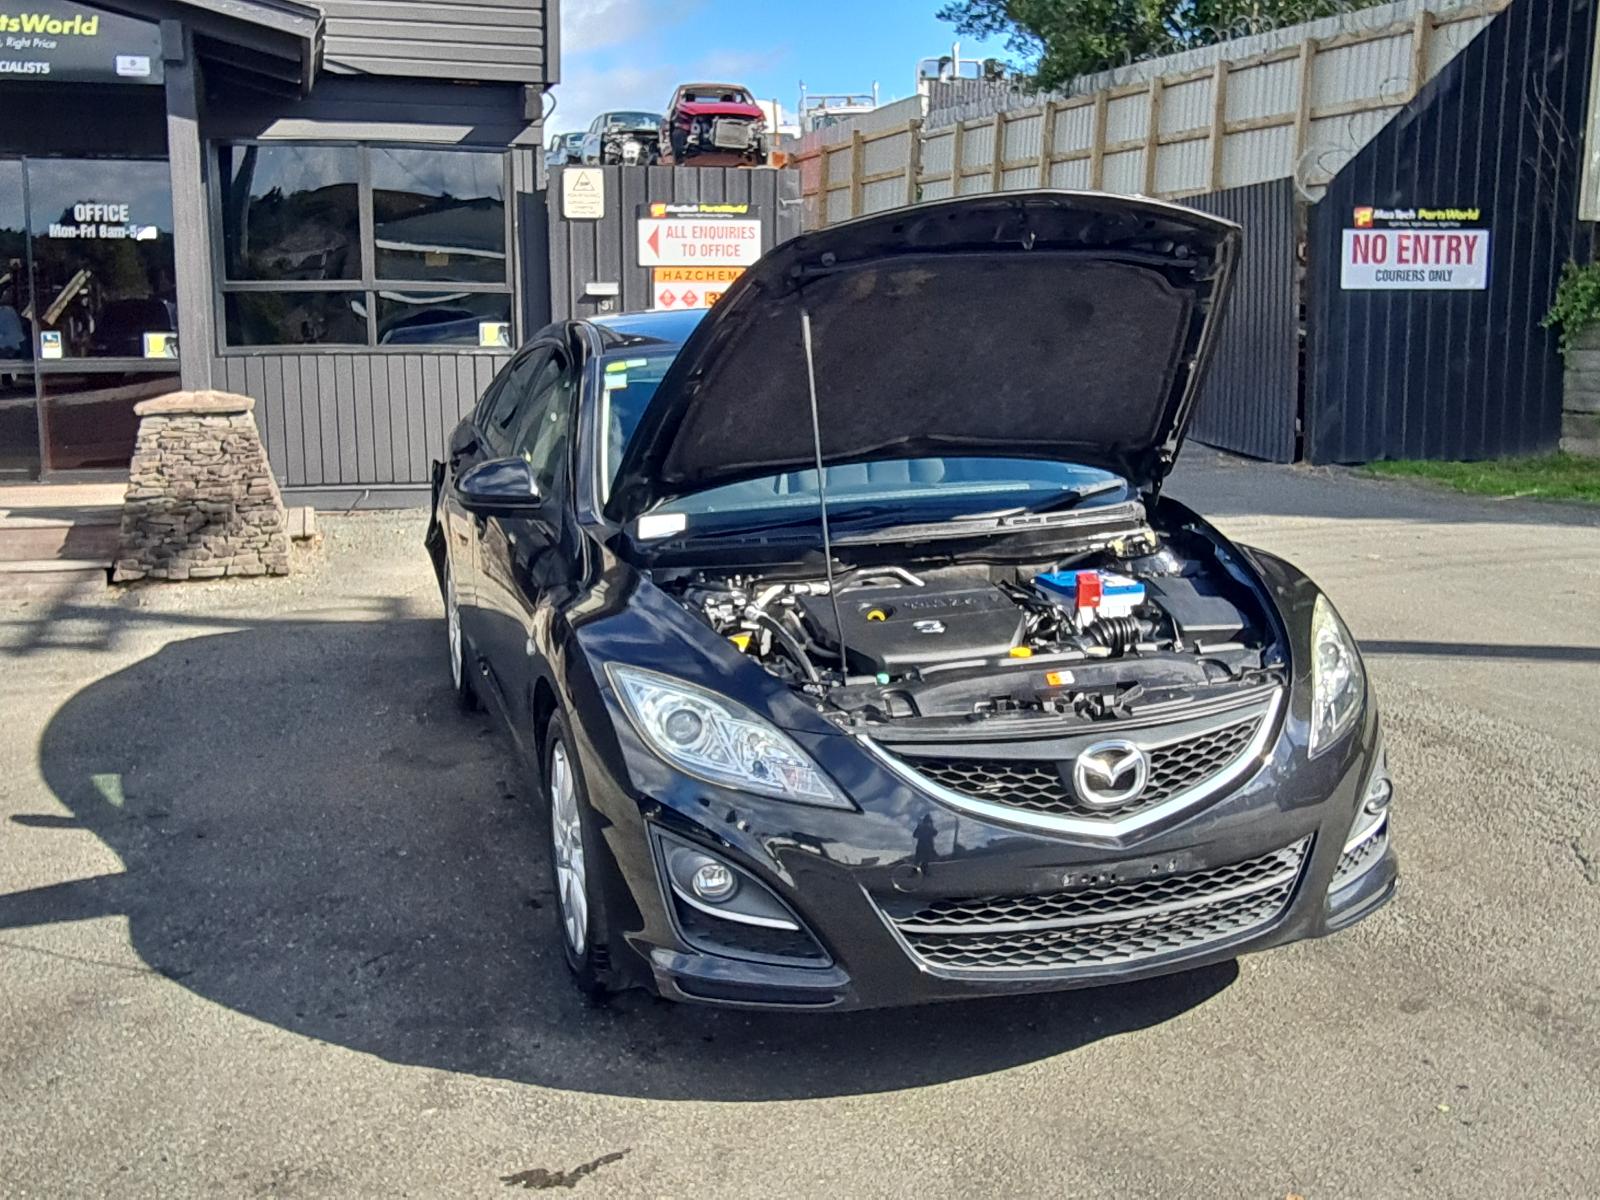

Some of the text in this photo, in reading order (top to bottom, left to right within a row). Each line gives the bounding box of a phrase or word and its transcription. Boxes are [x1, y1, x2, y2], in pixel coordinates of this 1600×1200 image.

[6, 36, 57, 50] Right Price
[73, 203, 129, 222] OFFICE
[48, 223, 148, 239] Mon-Fri 8am-5
[666, 226, 755, 240] ALL ENQUIRIES
[682, 244, 741, 257] TO OFFICE
[1352, 234, 1479, 265] NO ENTRY
[663, 270, 737, 281] HAZCHEM
[1375, 269, 1453, 282] COURIERS ONLY
[601, 299, 614, 311] 31
